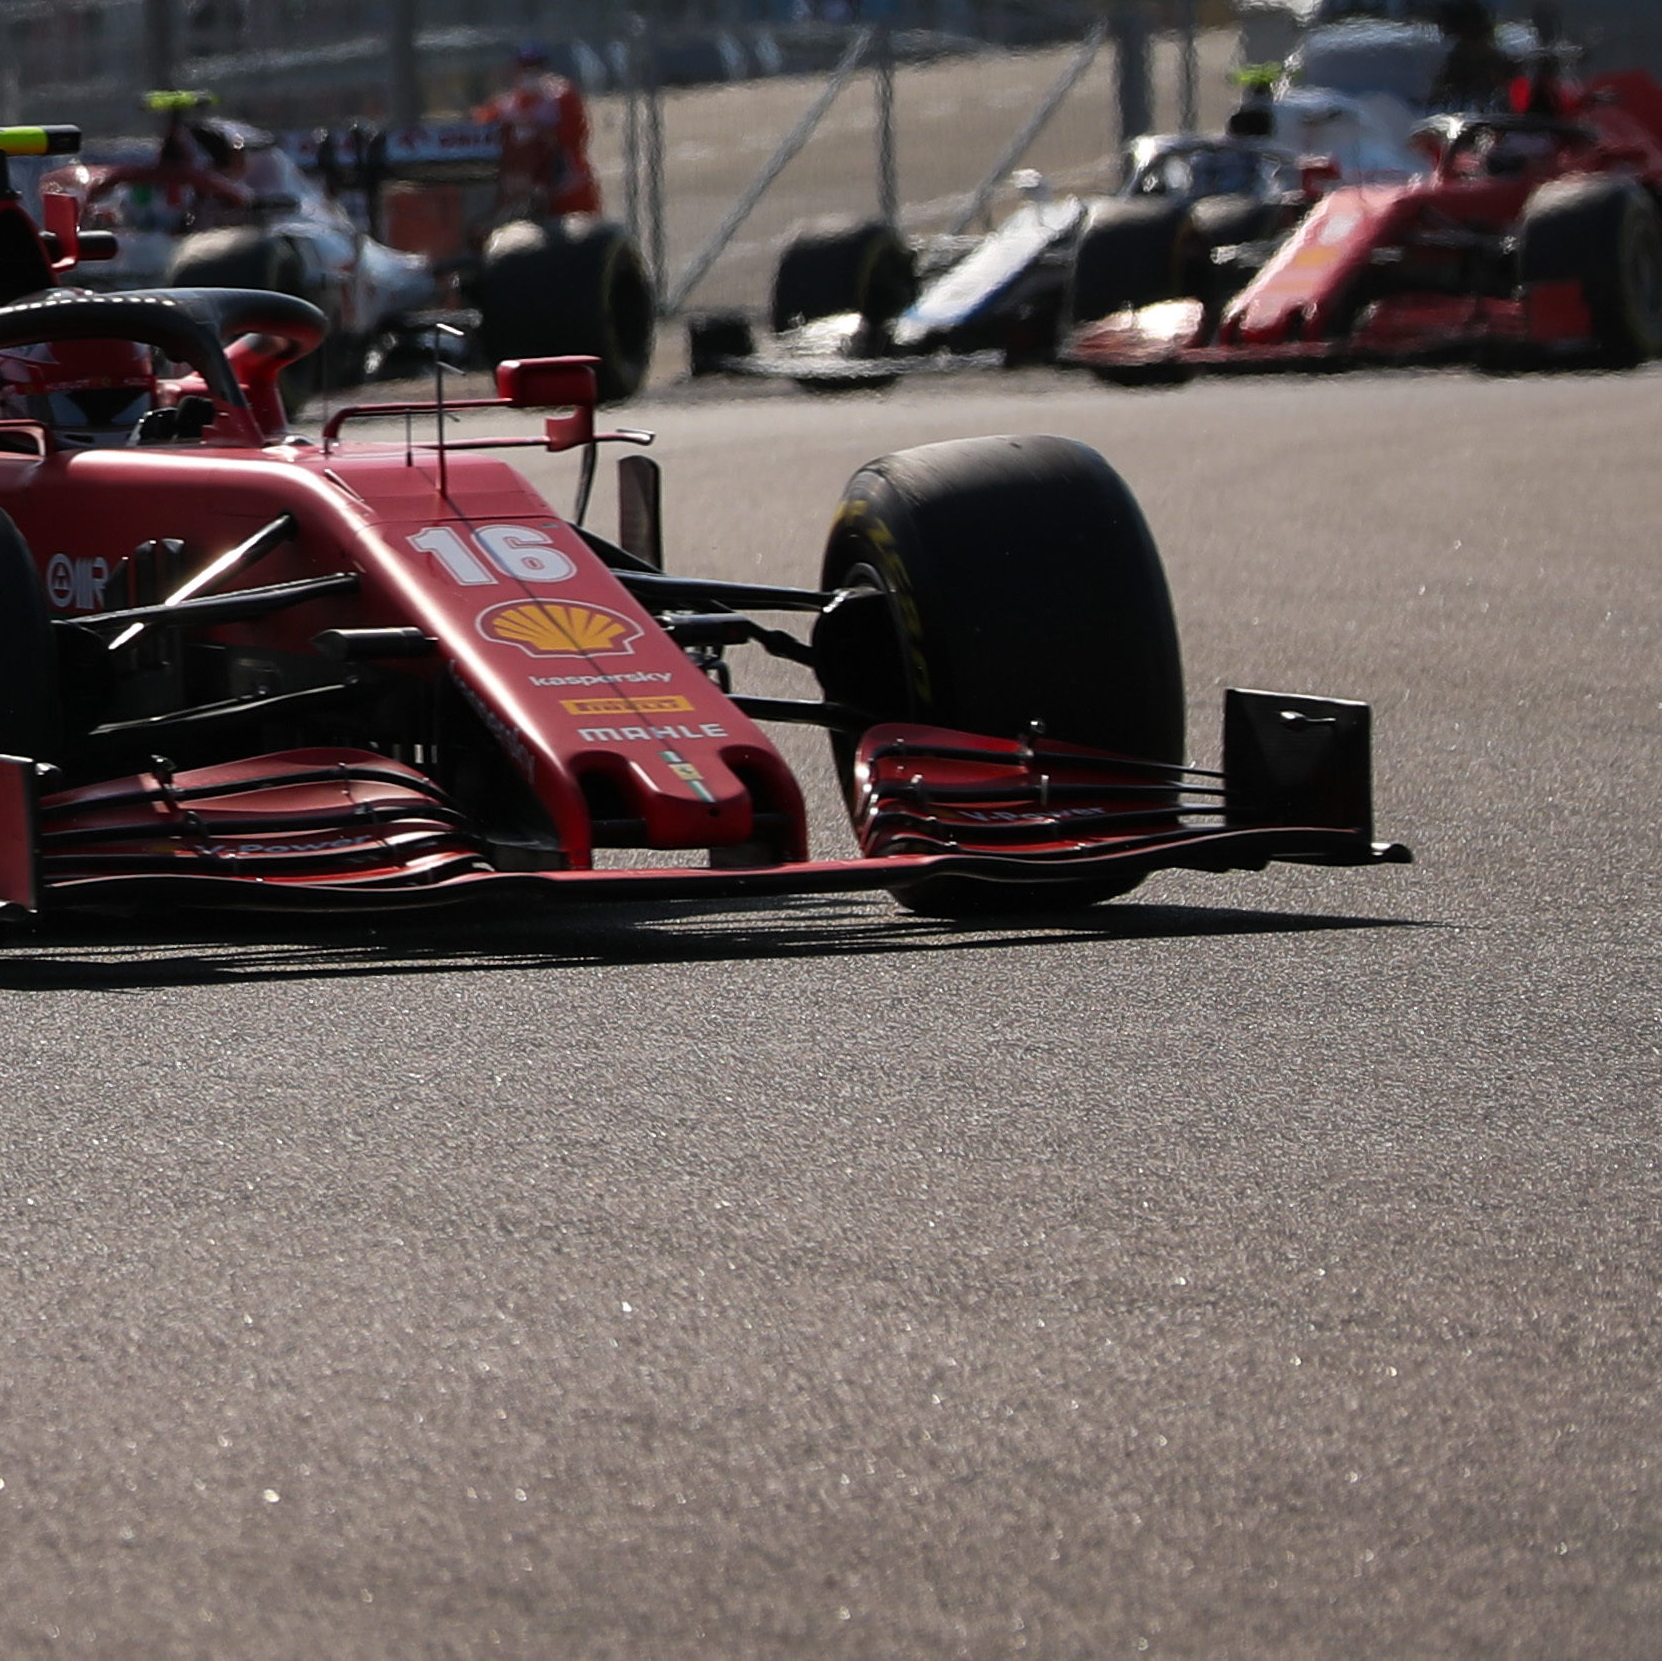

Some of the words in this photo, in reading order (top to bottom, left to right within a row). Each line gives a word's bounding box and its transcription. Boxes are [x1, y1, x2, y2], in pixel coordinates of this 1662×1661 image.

[407, 524, 578, 586] 16
[528, 671, 673, 687] kaspersky
[576, 722, 729, 742] MAHLE
[195, 835, 372, 855] V-Power
